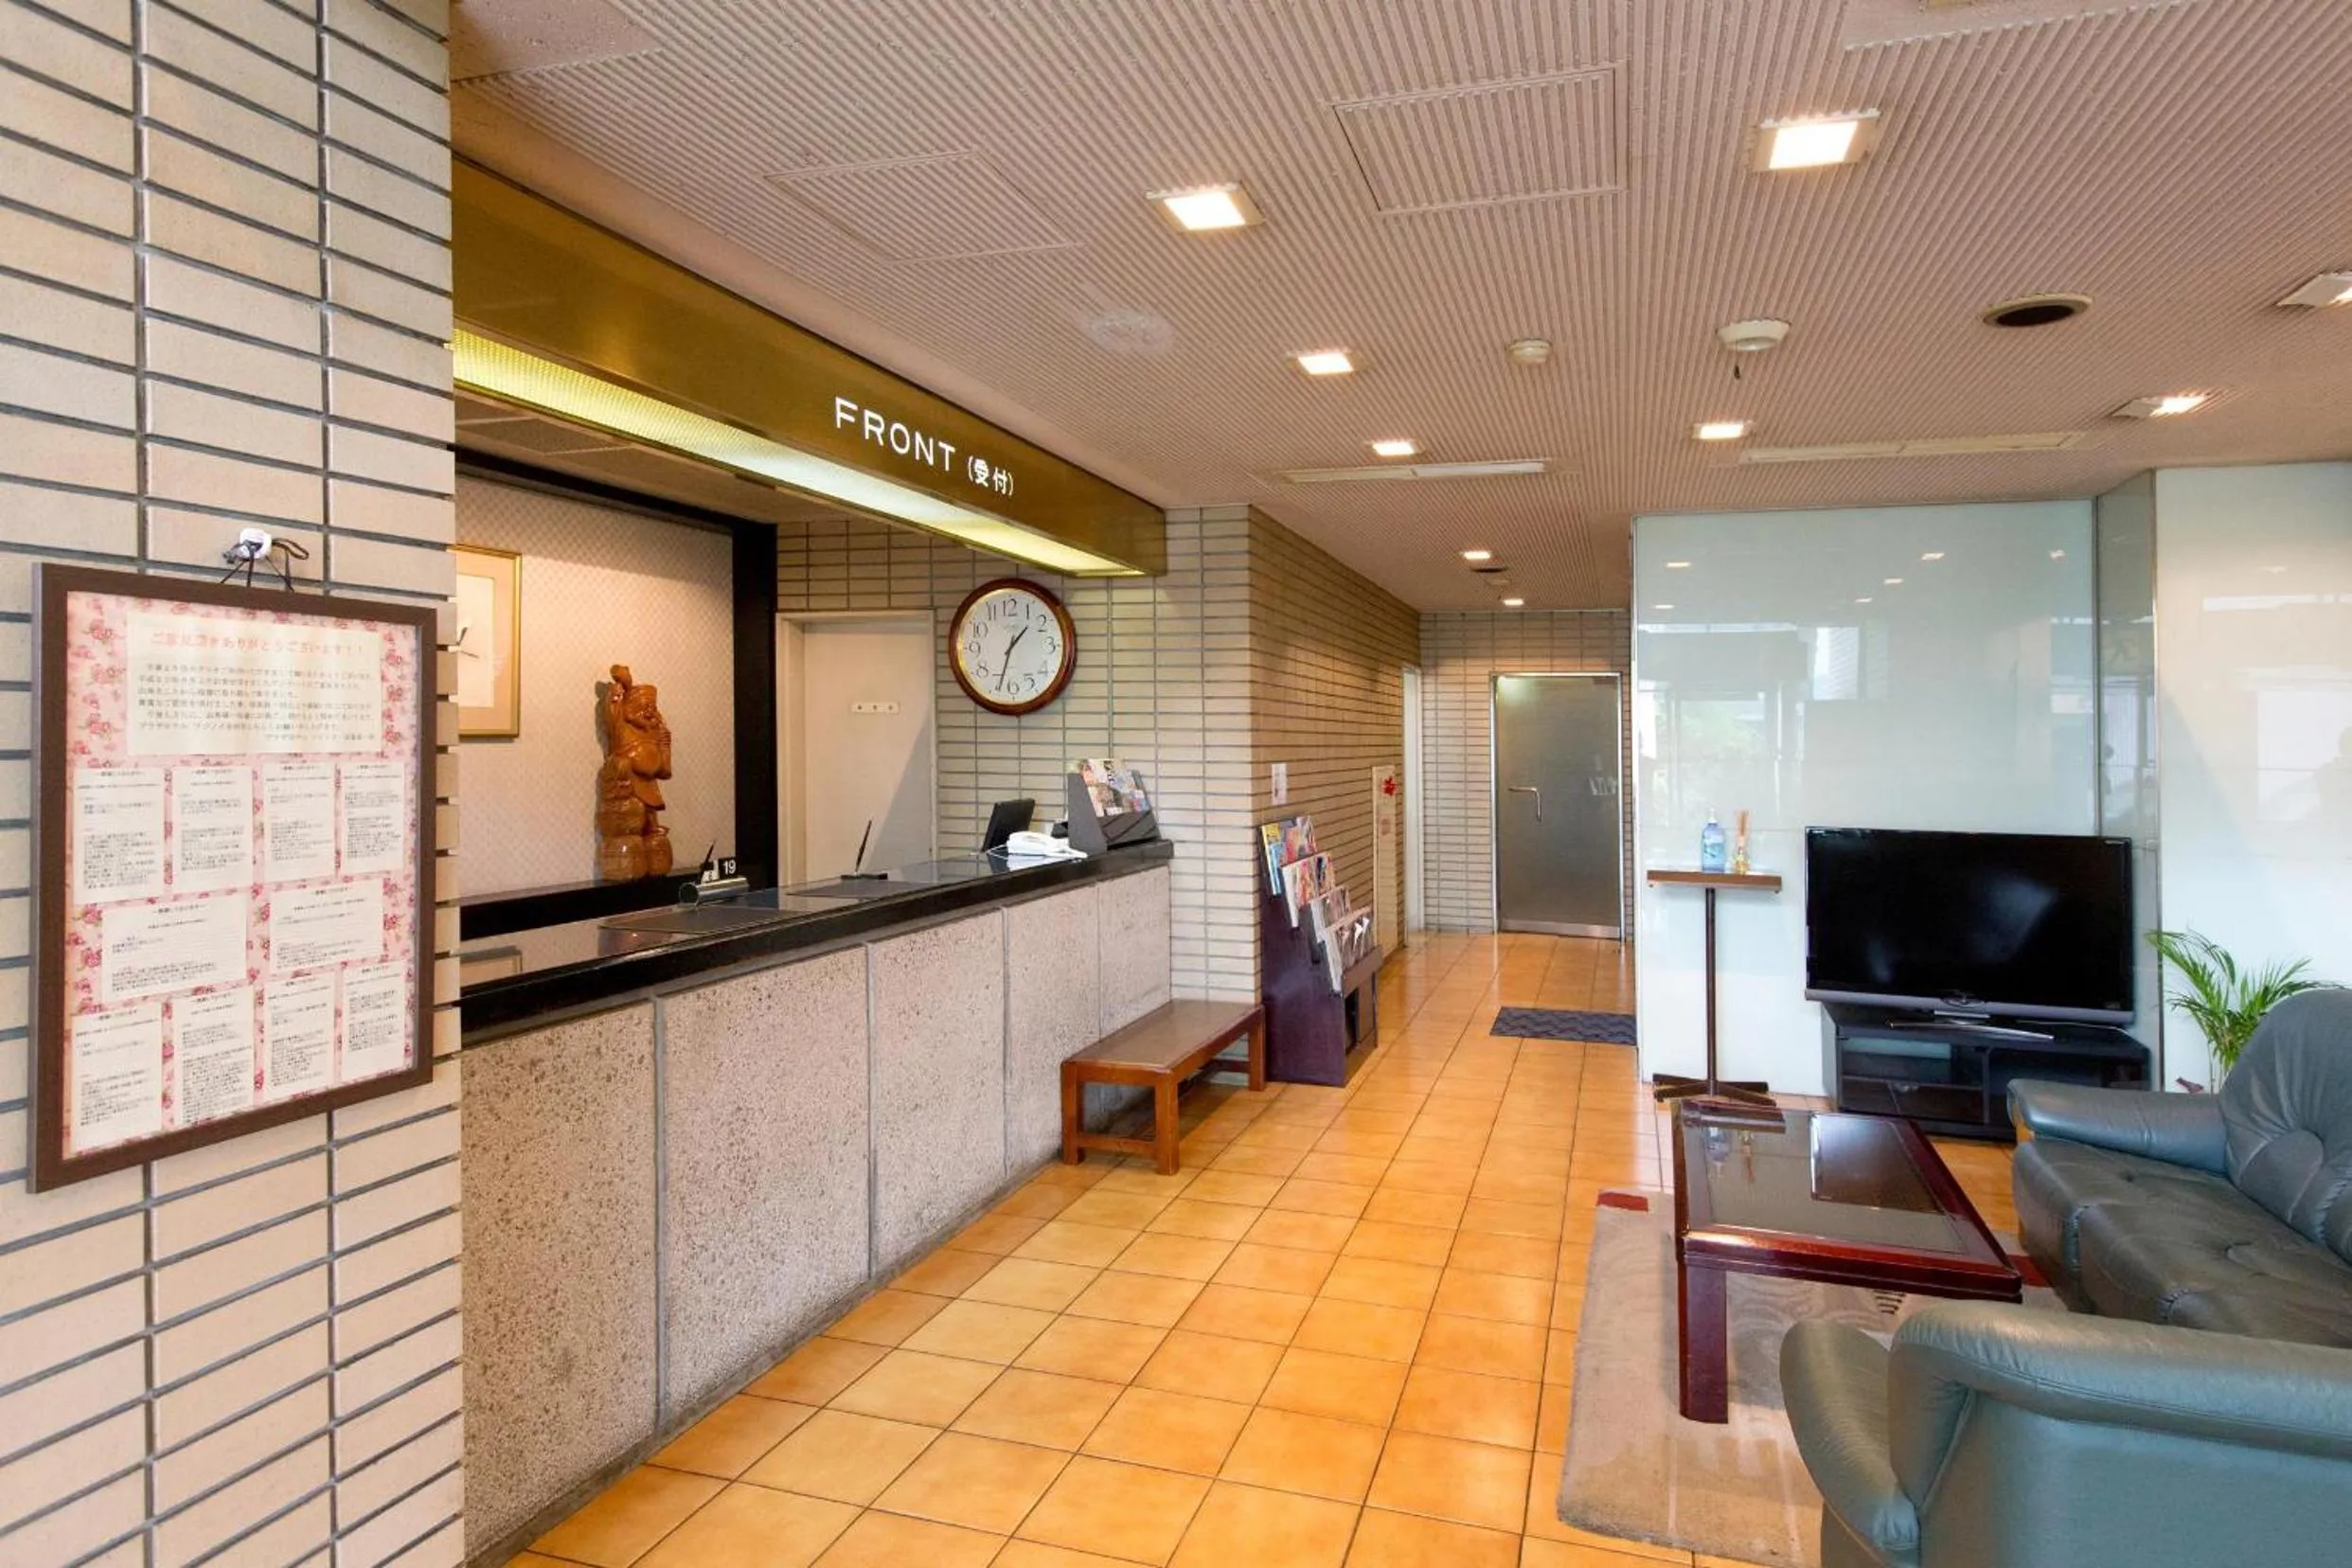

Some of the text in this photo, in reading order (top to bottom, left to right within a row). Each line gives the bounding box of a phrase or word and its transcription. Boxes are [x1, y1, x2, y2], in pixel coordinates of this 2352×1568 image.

[835, 396, 956, 472] FRONT
[986, 601, 997, 621] 11
[1003, 597, 1018, 617] 12
[972, 621, 989, 638] 10
[1037, 615, 1047, 633] 2
[969, 640, 981, 657] 9
[1044, 636, 1056, 655] 3
[976, 660, 989, 678] 8
[1037, 660, 1049, 677] 4
[1007, 676, 1020, 696] 6
[1024, 672, 1036, 690] 5
[722, 859, 736, 875] 19
